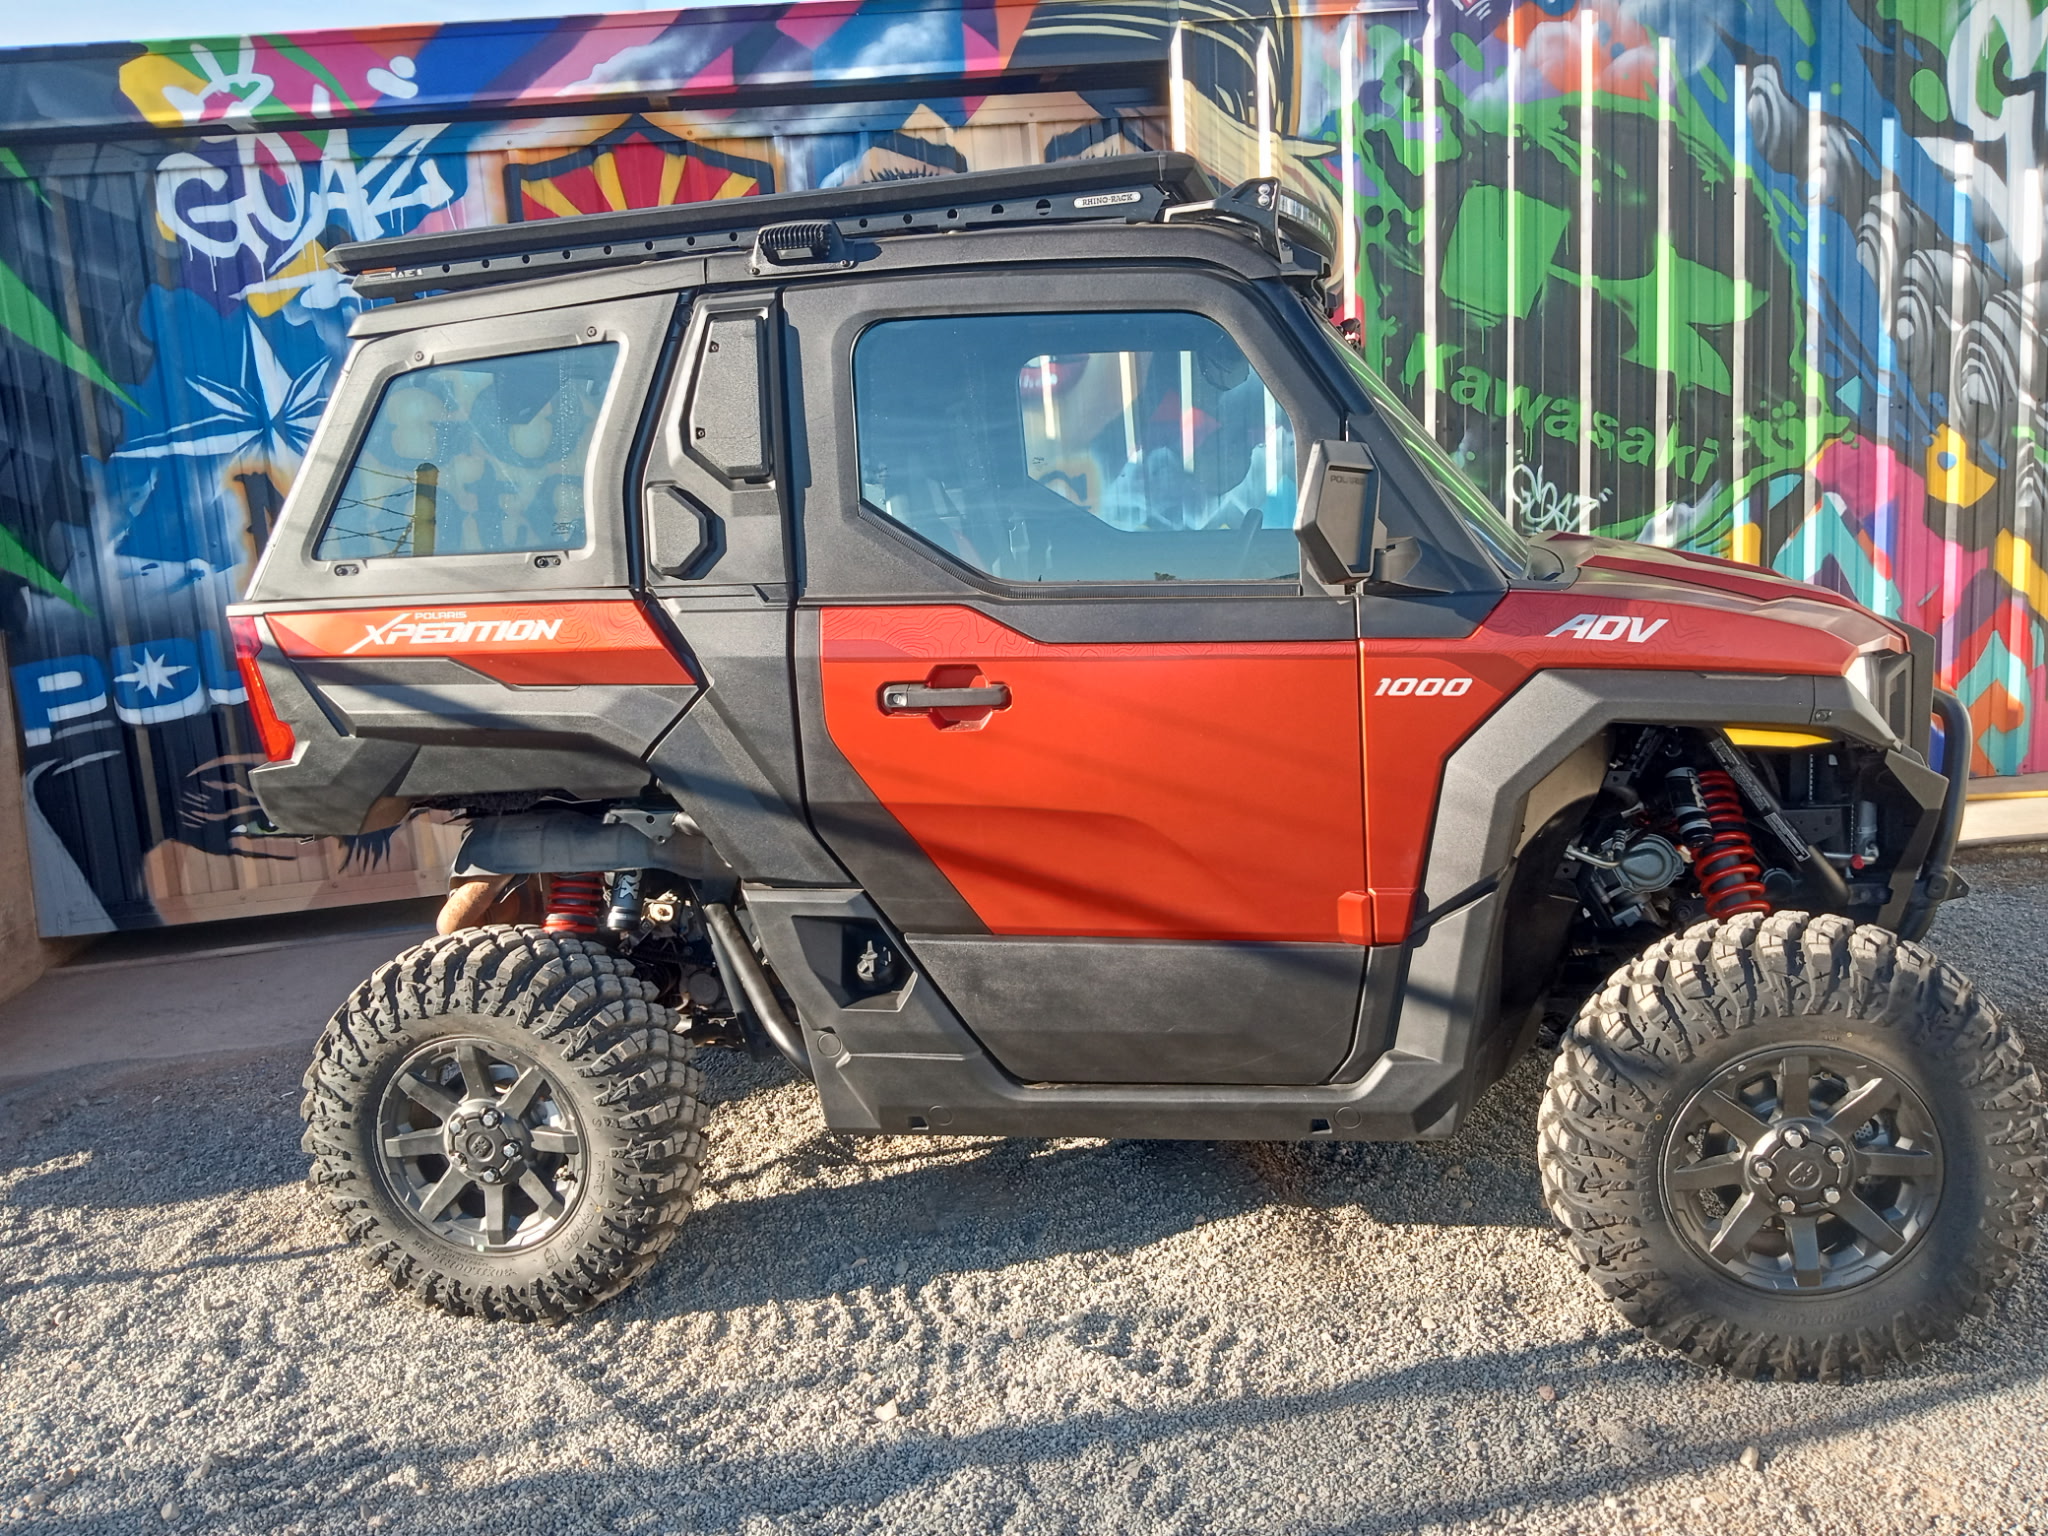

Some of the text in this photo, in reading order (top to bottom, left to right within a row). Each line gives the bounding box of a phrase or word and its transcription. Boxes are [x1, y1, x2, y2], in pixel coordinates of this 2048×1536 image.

[1082, 193, 1134, 206] RHINO-RACK
[414, 611, 467, 620] POLARIS
[342, 613, 564, 654] XPEDITION
[1545, 613, 1669, 643] ADV
[1374, 678, 1473, 697] 1000
